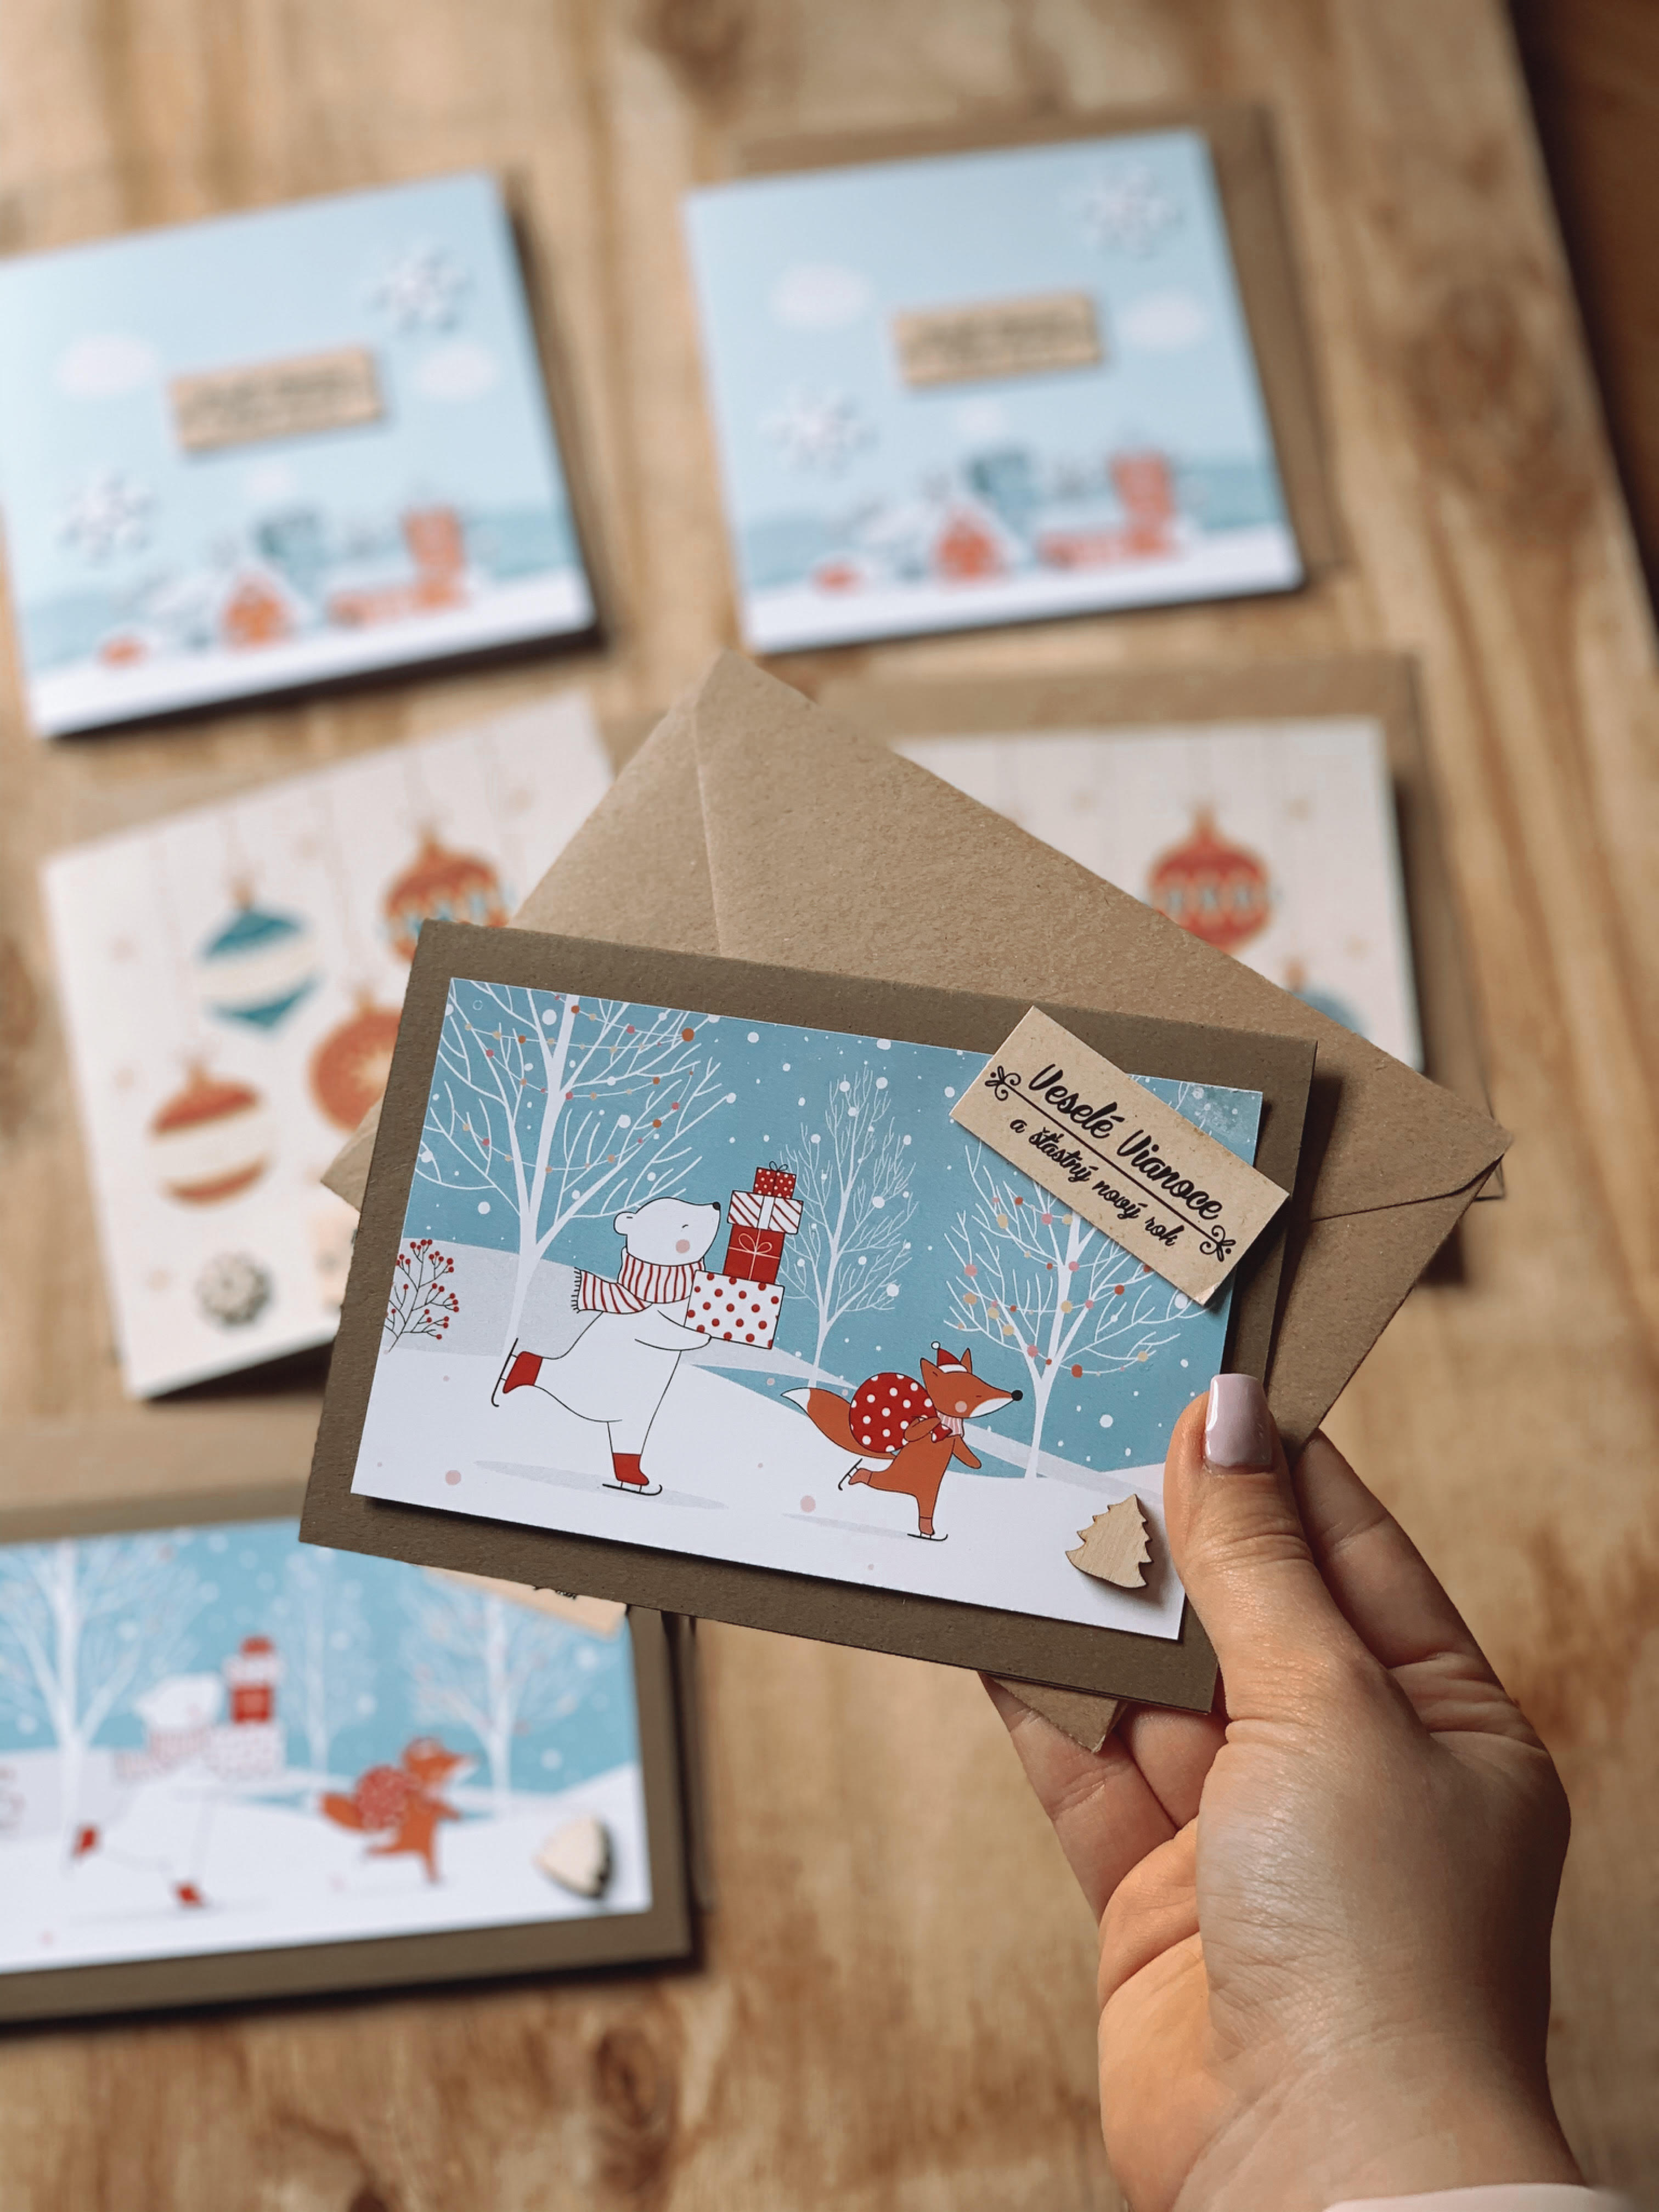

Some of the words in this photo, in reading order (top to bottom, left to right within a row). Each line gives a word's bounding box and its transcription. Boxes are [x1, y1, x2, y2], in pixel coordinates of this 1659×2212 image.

[1009, 1119, 1028, 1133] a
[1029, 1126, 1099, 1183] šťastný
[1091, 1179, 1149, 1220] nový
[1144, 1216, 1184, 1247] rok
[1028, 1063, 1125, 1139] Veselé
[1116, 1129, 1222, 1220] Vianoce
